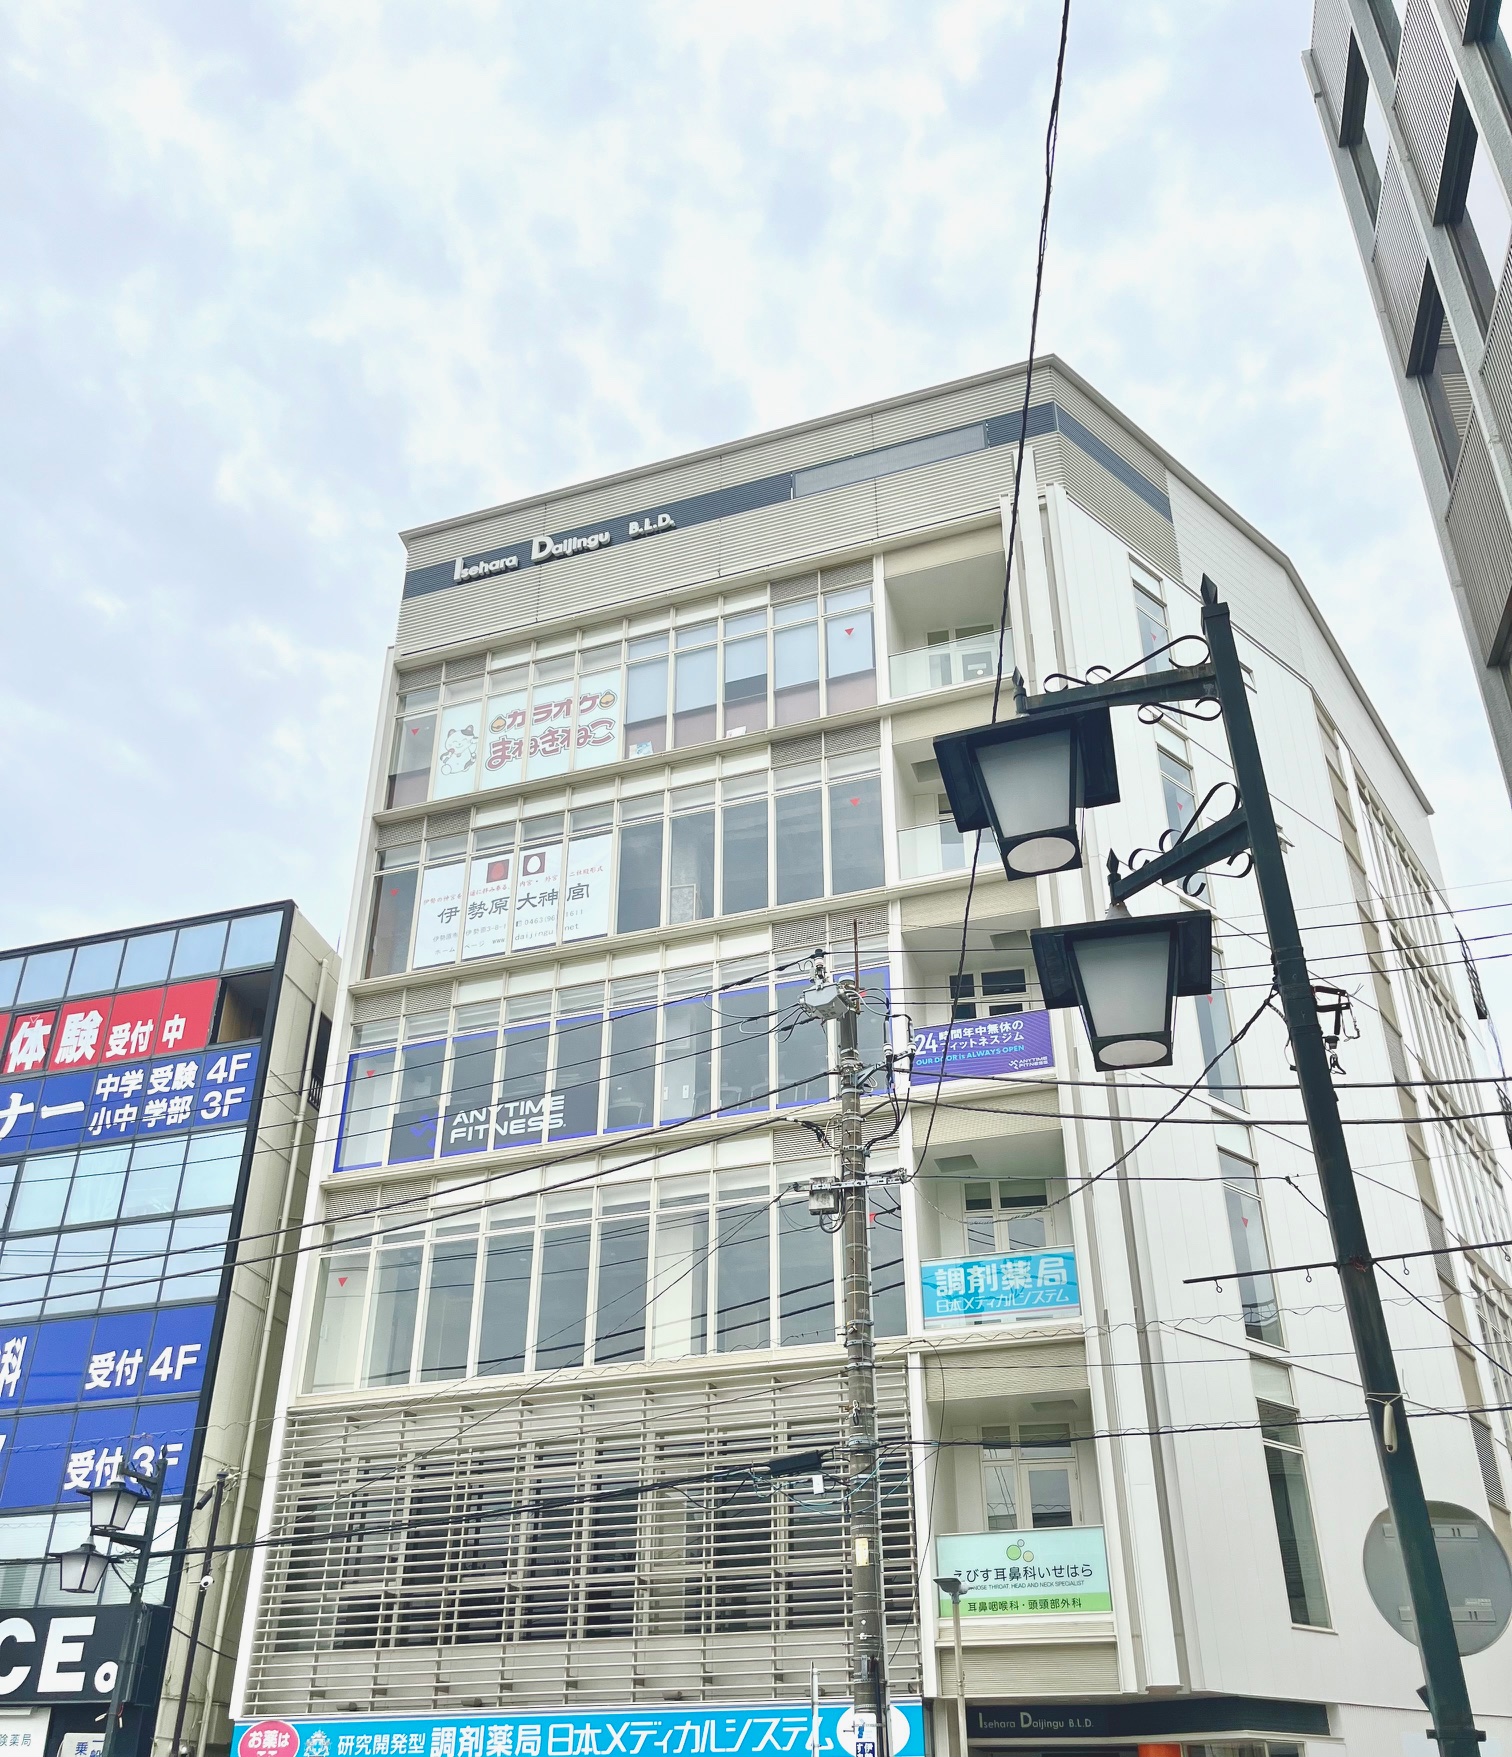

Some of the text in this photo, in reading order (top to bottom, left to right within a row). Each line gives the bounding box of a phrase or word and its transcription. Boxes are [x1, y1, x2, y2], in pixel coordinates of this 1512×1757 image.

[453, 513, 676, 582] Isehara Daijingu B.L.D.
[505, 693, 600, 731] カラオケ
[484, 717, 617, 772] まねきねこ
[437, 882, 590, 925] 伊勢原大神宮
[491, 923, 580, 944] wwwdaijingunet
[7, 1010, 186, 1072] 体験 受付中
[914, 1020, 1023, 1056] 24 時間年中無休の
[916, 1058, 934, 1066] OUR
[967, 1047, 1001, 1059] ALWAYS
[1002, 1044, 1025, 1053] OPEN
[939, 1031, 1025, 1052] フィットネスジム
[95, 1052, 252, 1102] 中学受験 4F
[87, 1087, 246, 1136] 小中学部 3F
[452, 1094, 566, 1126] ANYTIME
[935, 1257, 1067, 1297] 調剤薬局
[936, 1288, 1069, 1313] 日本メディカルシステム
[85, 1343, 202, 1390] 受付 4F
[63, 1446, 123, 1490] 受付
[953, 1563, 1093, 1584] えびす耳鼻科いせはら
[248, 1729, 290, 1749] お薬は
[337, 1716, 834, 1757] 研究開発型 調剤薬局 日本メディカルシステム
[978, 1711, 1094, 1730] Isehara Daijingu B.L.D.
